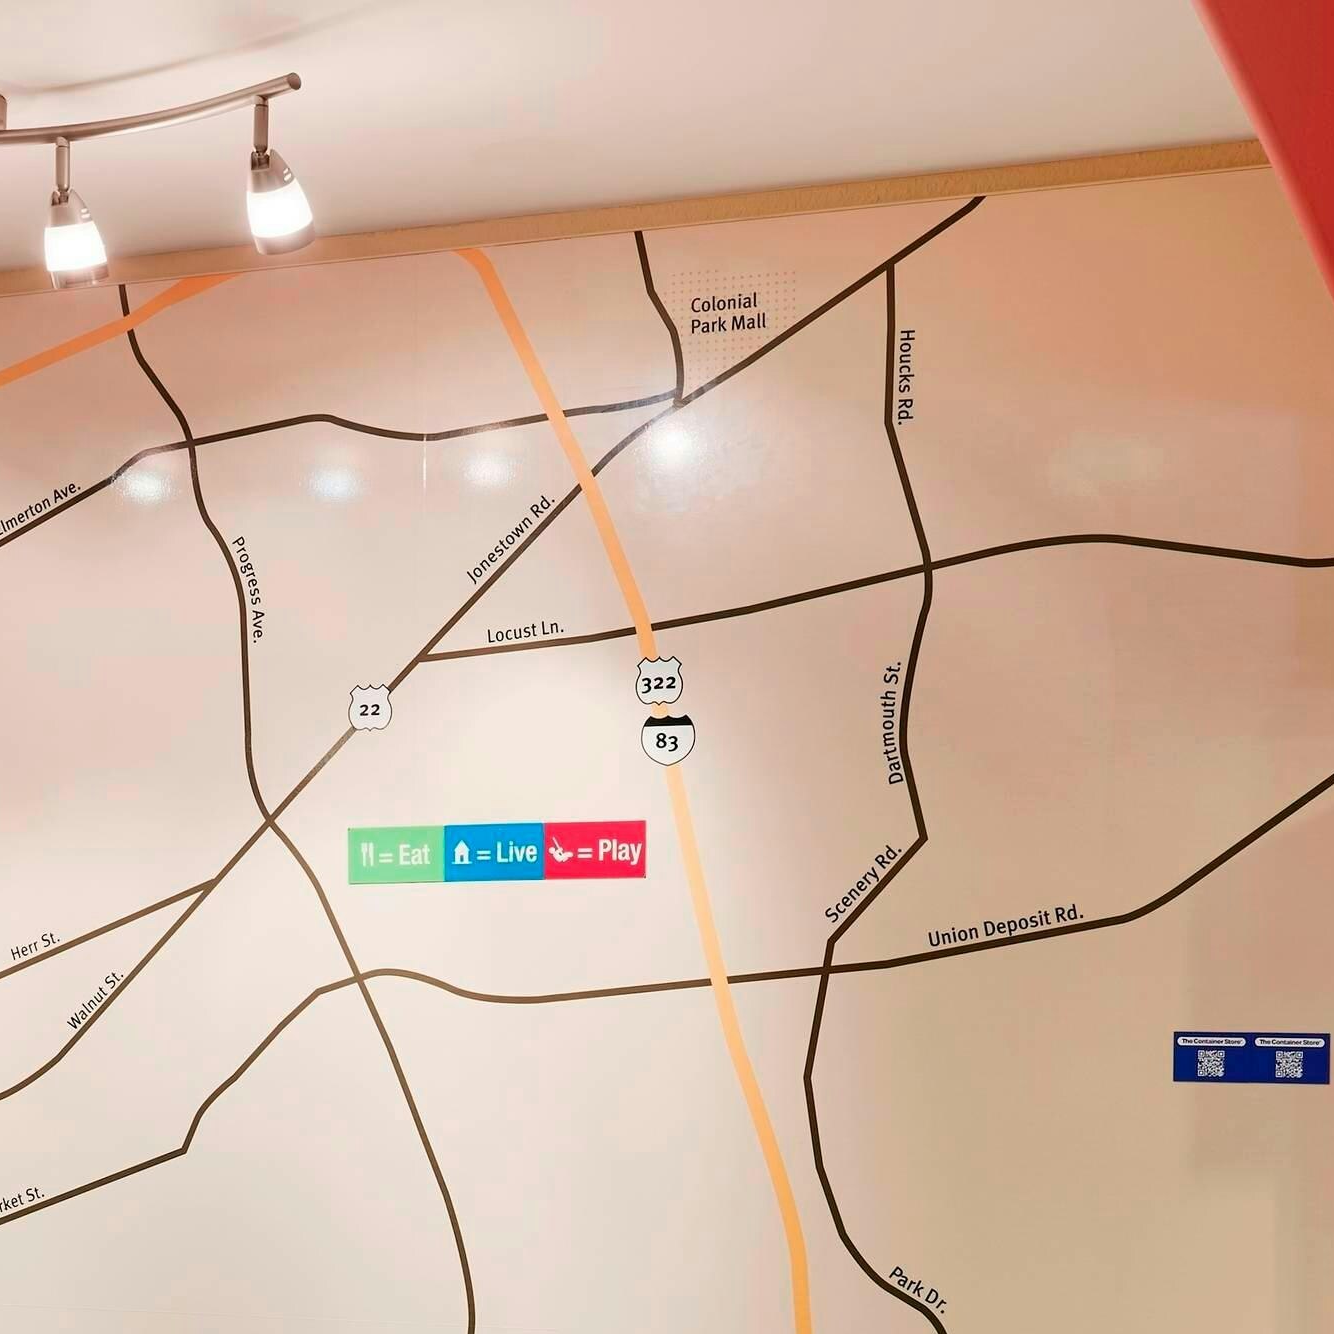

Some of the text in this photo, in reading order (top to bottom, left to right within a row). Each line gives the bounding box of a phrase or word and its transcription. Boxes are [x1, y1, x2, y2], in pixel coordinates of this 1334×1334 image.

[691, 292, 758, 313] Colonial
[691, 313, 766, 334] Park Mall
[899, 329, 916, 426] Houcks Rd.
[51, 482, 82, 508] Ave.
[467, 495, 556, 584] Jonestown Rd.
[232, 536, 265, 643] Progress Ave.
[487, 621, 564, 643] Locust Ln.
[641, 675, 676, 693] 322
[359, 704, 380, 716] 22
[880, 661, 904, 785] Dartmouth St.
[656, 732, 679, 752] 83
[399, 844, 430, 865] Eat
[497, 842, 538, 863] Live
[599, 839, 642, 866] Play
[824, 844, 902, 924] Scenery Rd.
[928, 905, 1085, 948] Union Deposit Rd.
[10, 932, 60, 961] Herr St.
[66, 971, 124, 1031] Walnut St.
[26, 1186, 45, 1203] St.
[889, 1266, 948, 1314] Park Dr.
